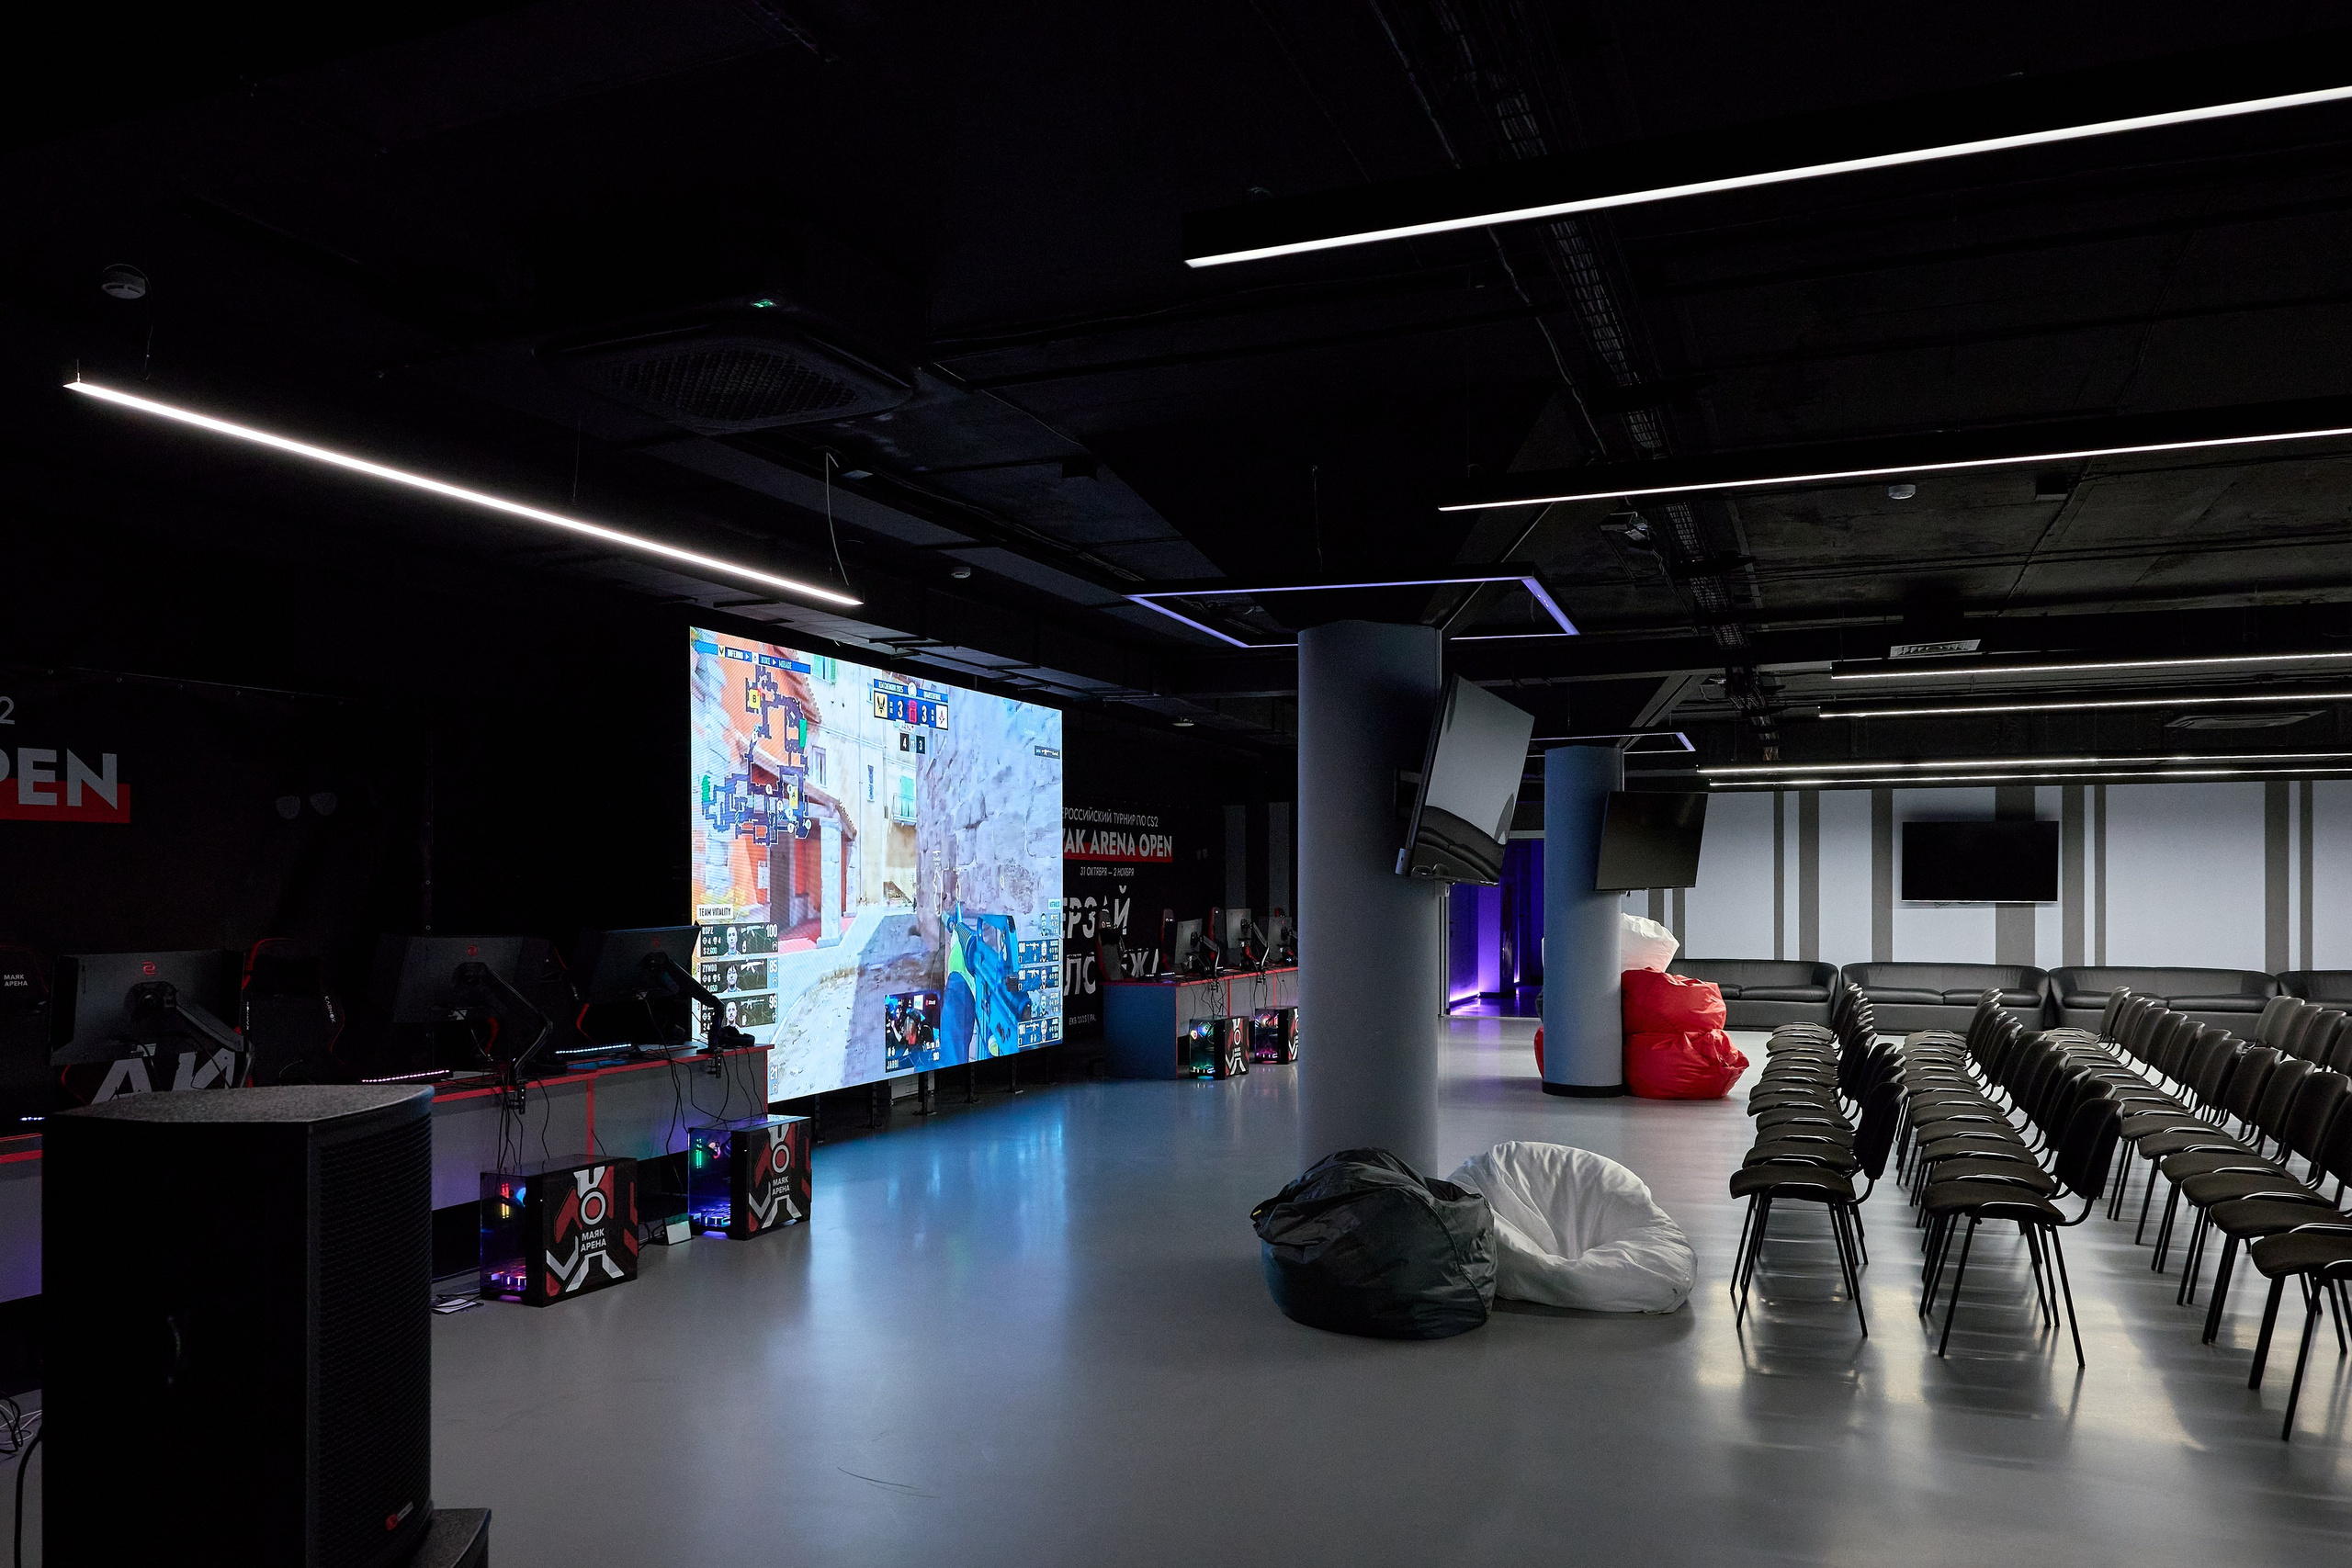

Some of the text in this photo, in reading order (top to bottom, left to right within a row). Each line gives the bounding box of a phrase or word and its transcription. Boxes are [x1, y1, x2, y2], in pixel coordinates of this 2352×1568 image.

[898, 701, 903, 718] 3
[922, 705, 927, 723] 3
[902, 738, 907, 749] 4
[919, 740, 923, 751] 3
[1089, 829, 1136, 856] ARENA
[1139, 833, 1172, 858] OPEN
[1080, 867, 1086, 876] 31
[1086, 867, 1108, 876] ОКТЯБРЯ
[699, 907, 731, 917] TEAM VITALITY
[766, 924, 778, 938] 100
[769, 960, 778, 974] 85
[768, 995, 778, 1010] 96
[770, 1066, 778, 1080] 21
[772, 1175, 789, 1188] МАЯК
[772, 1184, 790, 1196] АРЕНА
[581, 1227, 605, 1242] МАЯК
[580, 1237, 607, 1253] АРЕНА
